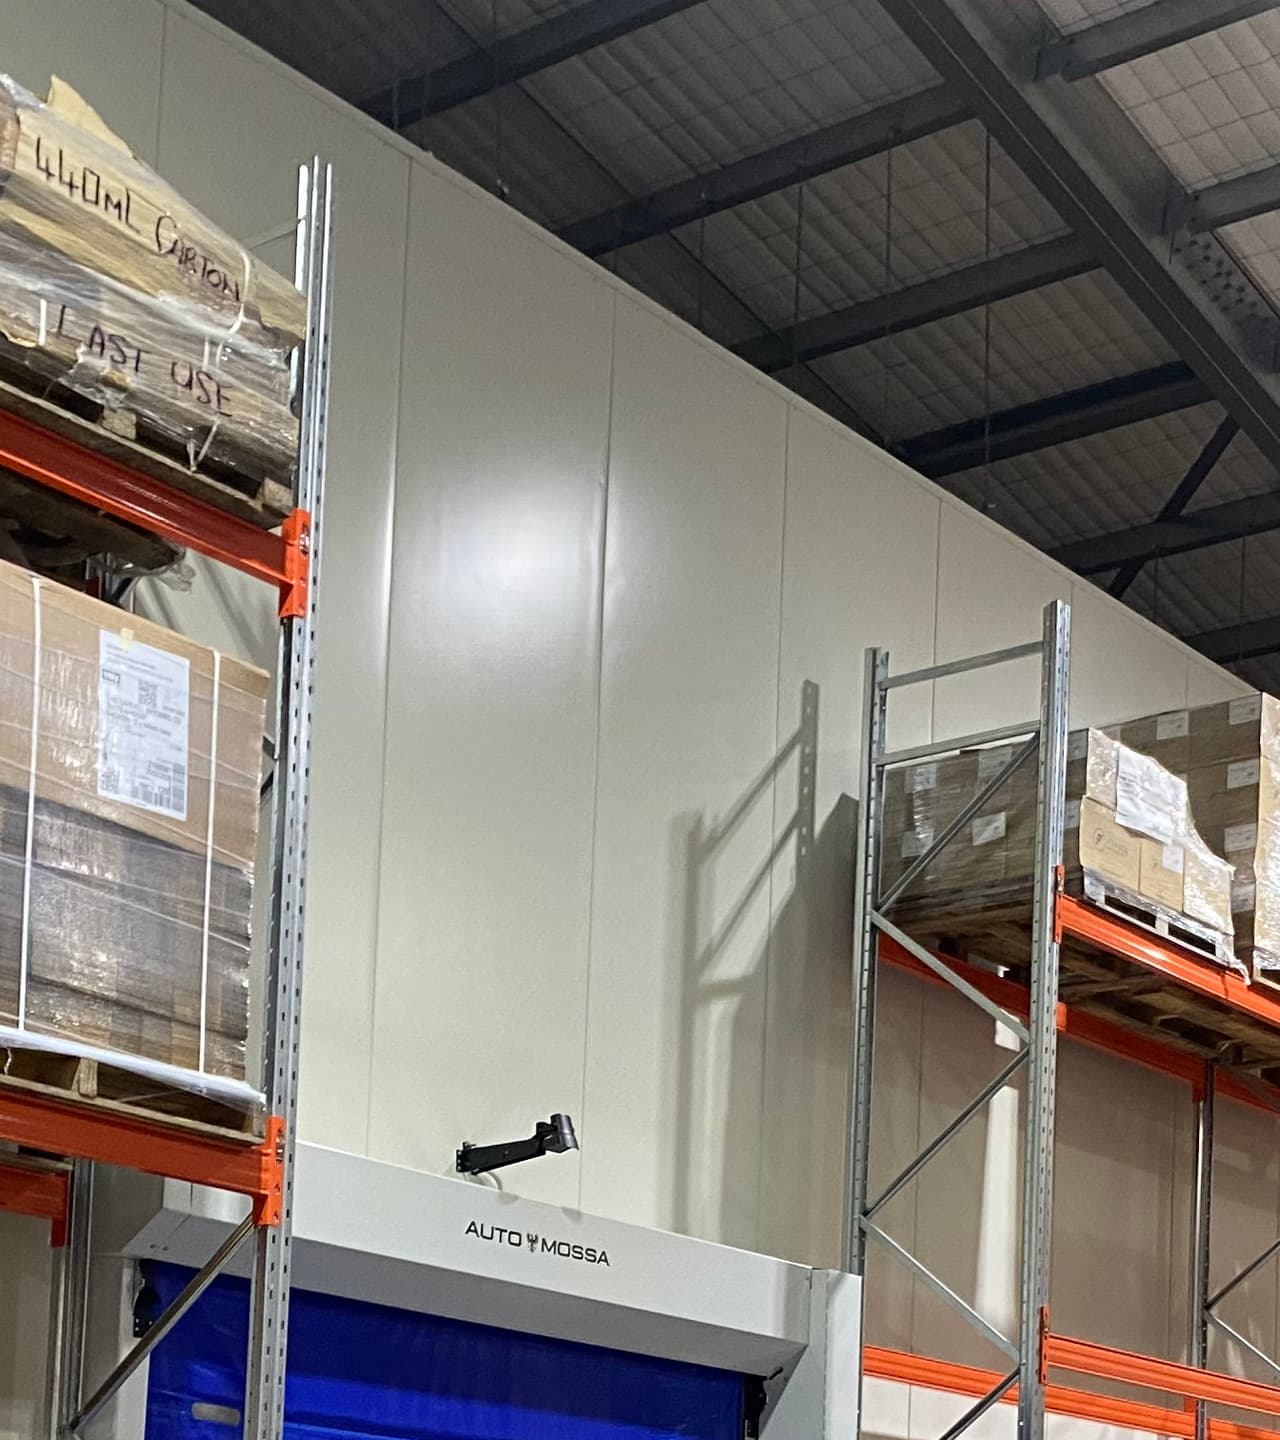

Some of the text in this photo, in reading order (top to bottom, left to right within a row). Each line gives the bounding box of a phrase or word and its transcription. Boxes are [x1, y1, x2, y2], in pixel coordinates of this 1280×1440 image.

[57, 304, 233, 417] LAST USE
[465, 1220, 610, 1266] AUTO MOSSA
